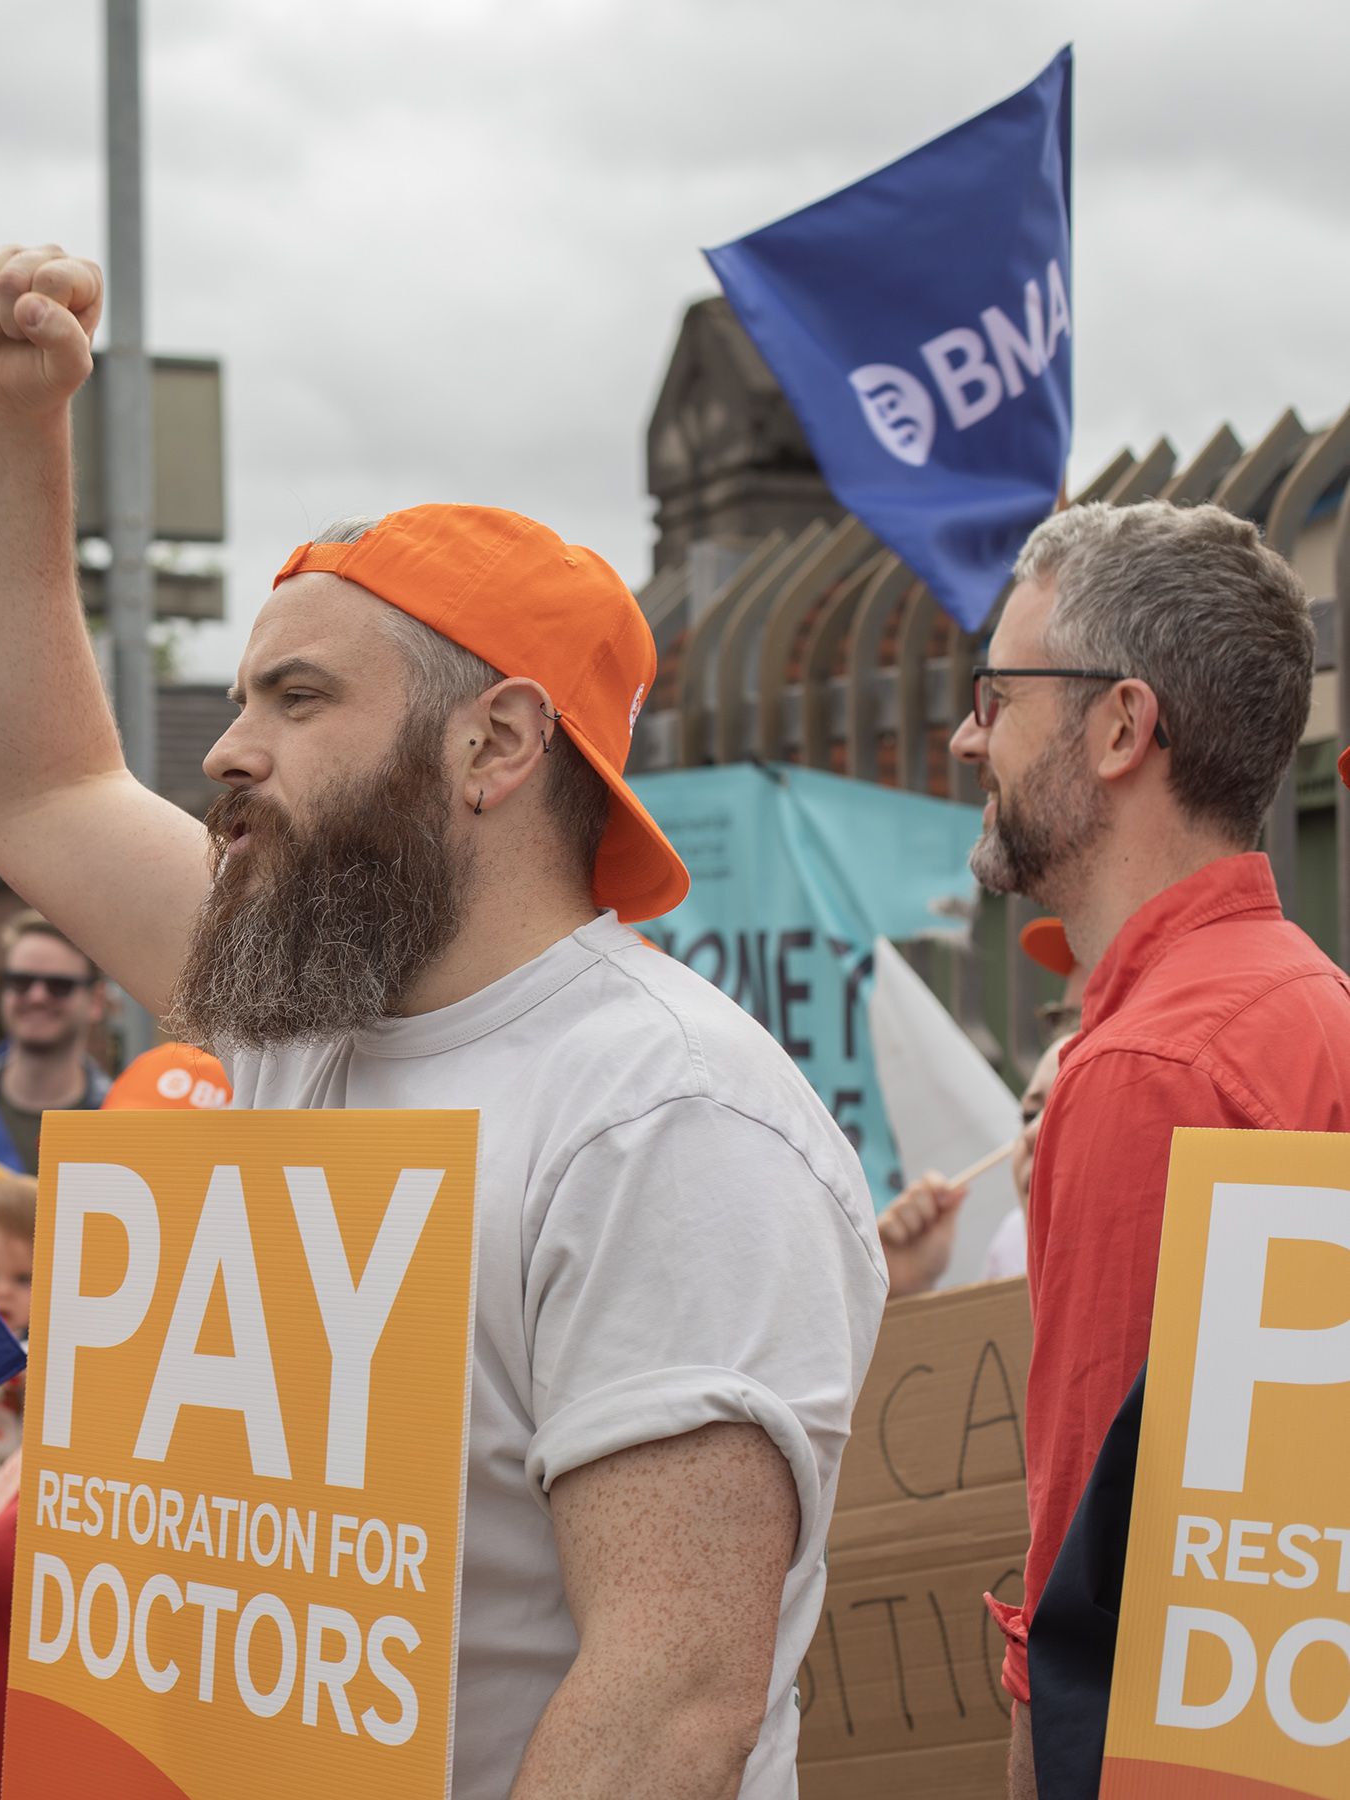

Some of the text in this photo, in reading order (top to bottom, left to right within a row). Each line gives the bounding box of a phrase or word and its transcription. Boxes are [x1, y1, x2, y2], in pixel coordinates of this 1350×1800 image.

[41, 1162, 447, 1490] PAY
[36, 1469, 429, 1593] RESTORATION FOR
[27, 1551, 423, 1747] DOCTORS
[1154, 1605, 1350, 1748] DO
